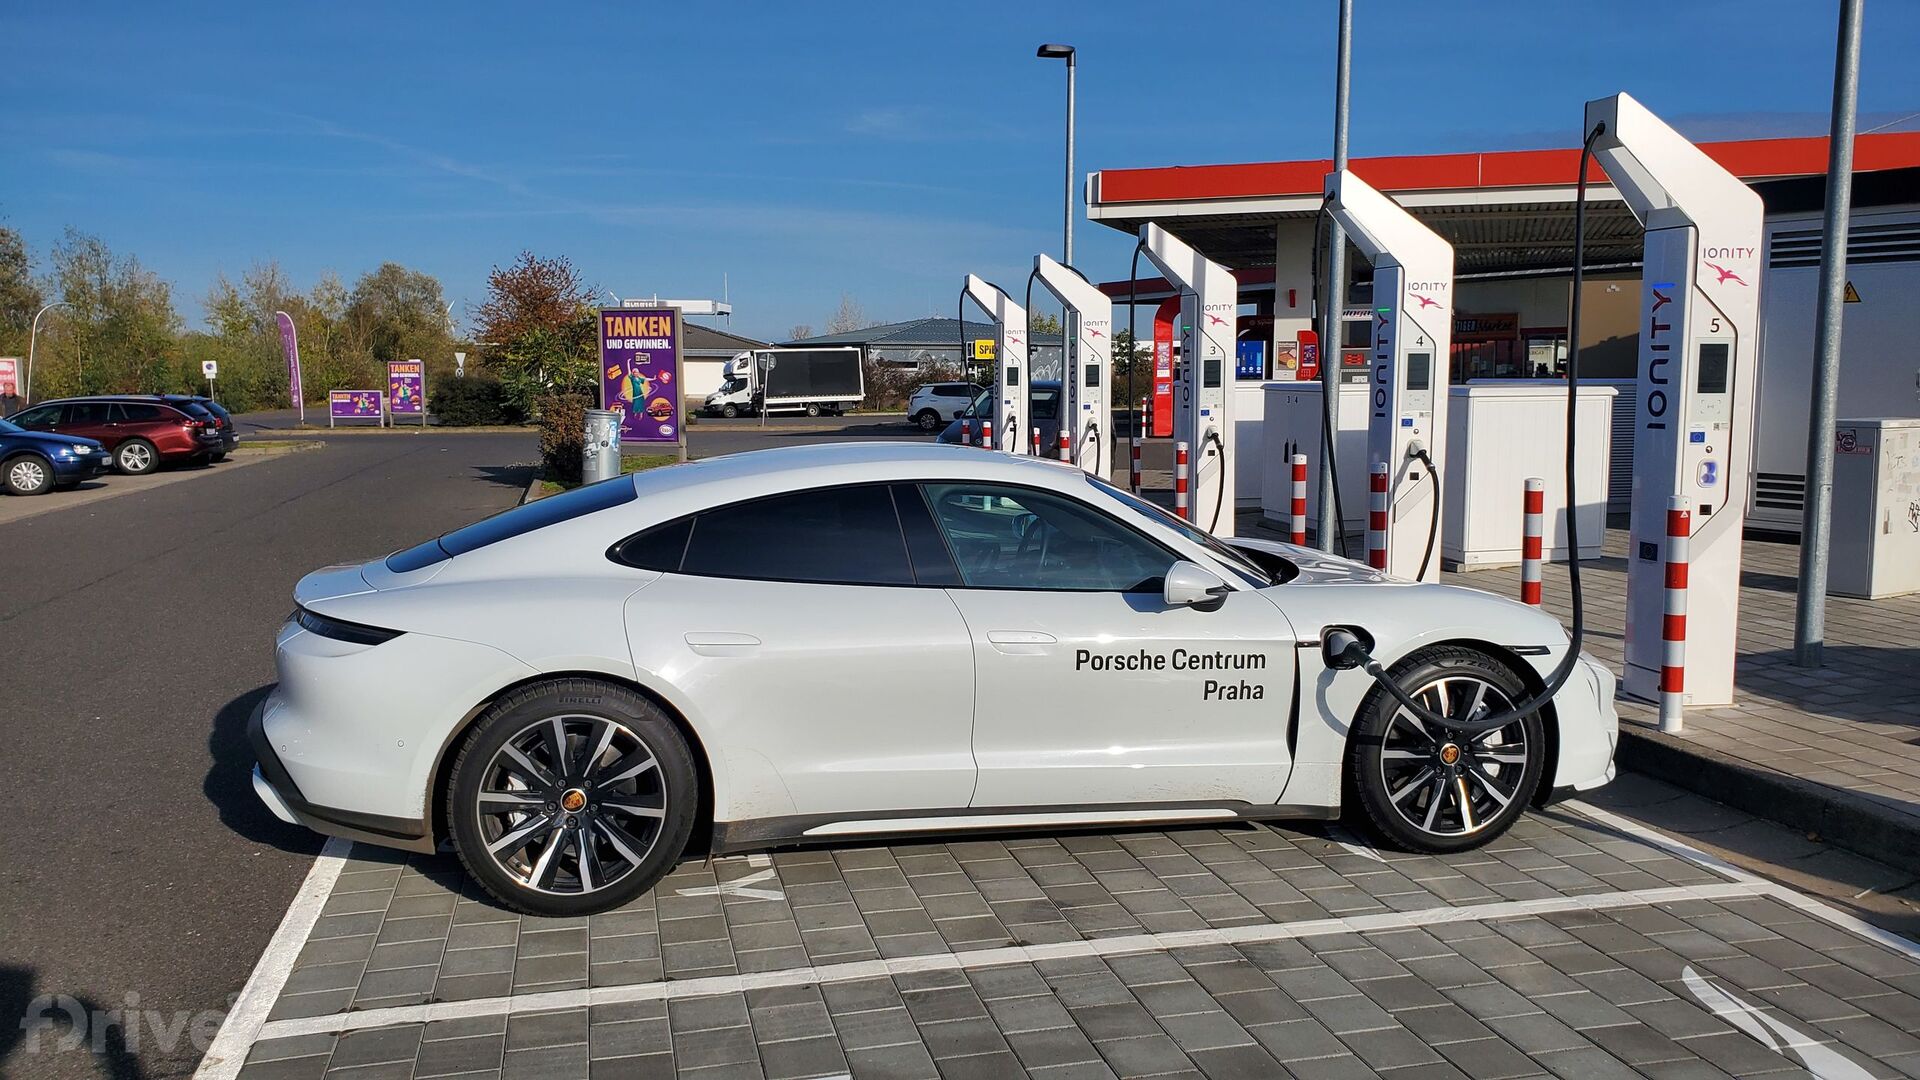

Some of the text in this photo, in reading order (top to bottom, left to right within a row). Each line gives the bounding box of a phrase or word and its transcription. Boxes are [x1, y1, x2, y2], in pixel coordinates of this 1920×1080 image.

[1703, 247, 1754, 258] IONITY
[1408, 282, 1447, 291] IONITY
[1202, 304, 1232, 312] IONITY
[605, 316, 671, 337] TANKEN
[1710, 318, 1720, 333] 5
[606, 339, 672, 349] UND GEWINNEN.
[1416, 335, 1424, 346] 4
[1210, 346, 1217, 355] 3
[1375, 313, 1389, 418] IONITY
[1647, 289, 1672, 430] IONITY
[390, 364, 420, 373] TANKEN
[1183, 330, 1191, 409] IONITY
[1075, 648, 1266, 671] Porsche Centrum
[1203, 680, 1264, 701] Praha
